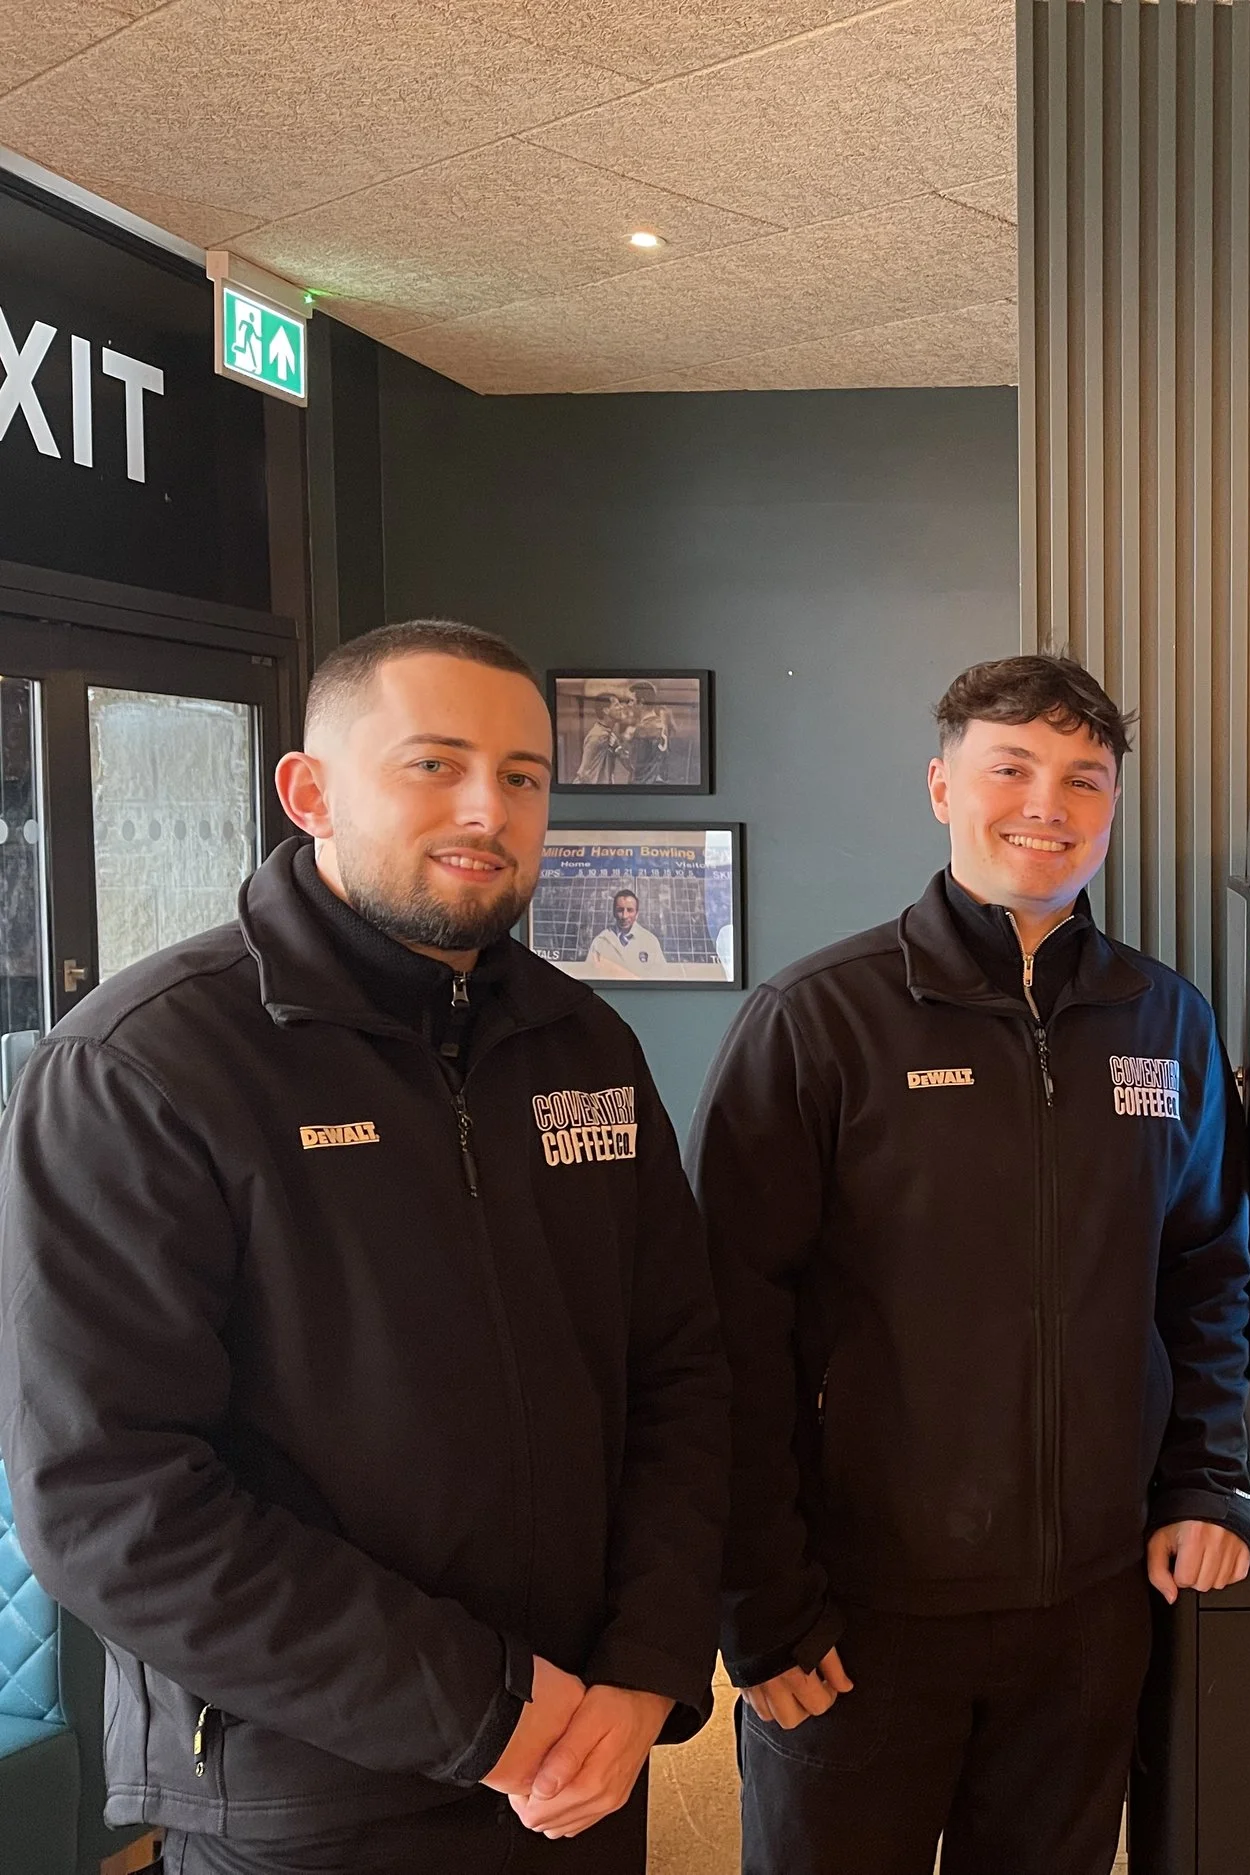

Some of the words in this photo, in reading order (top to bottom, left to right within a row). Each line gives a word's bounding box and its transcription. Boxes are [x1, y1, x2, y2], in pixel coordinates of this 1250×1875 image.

[541, 847, 585, 857] Milford
[591, 846, 634, 857] Haven
[640, 846, 696, 860] Bowling
[532, 1086, 635, 1132] COVENTRY
[1113, 1088, 1165, 1117] COFFEE
[541, 1125, 615, 1167] COFFEE
